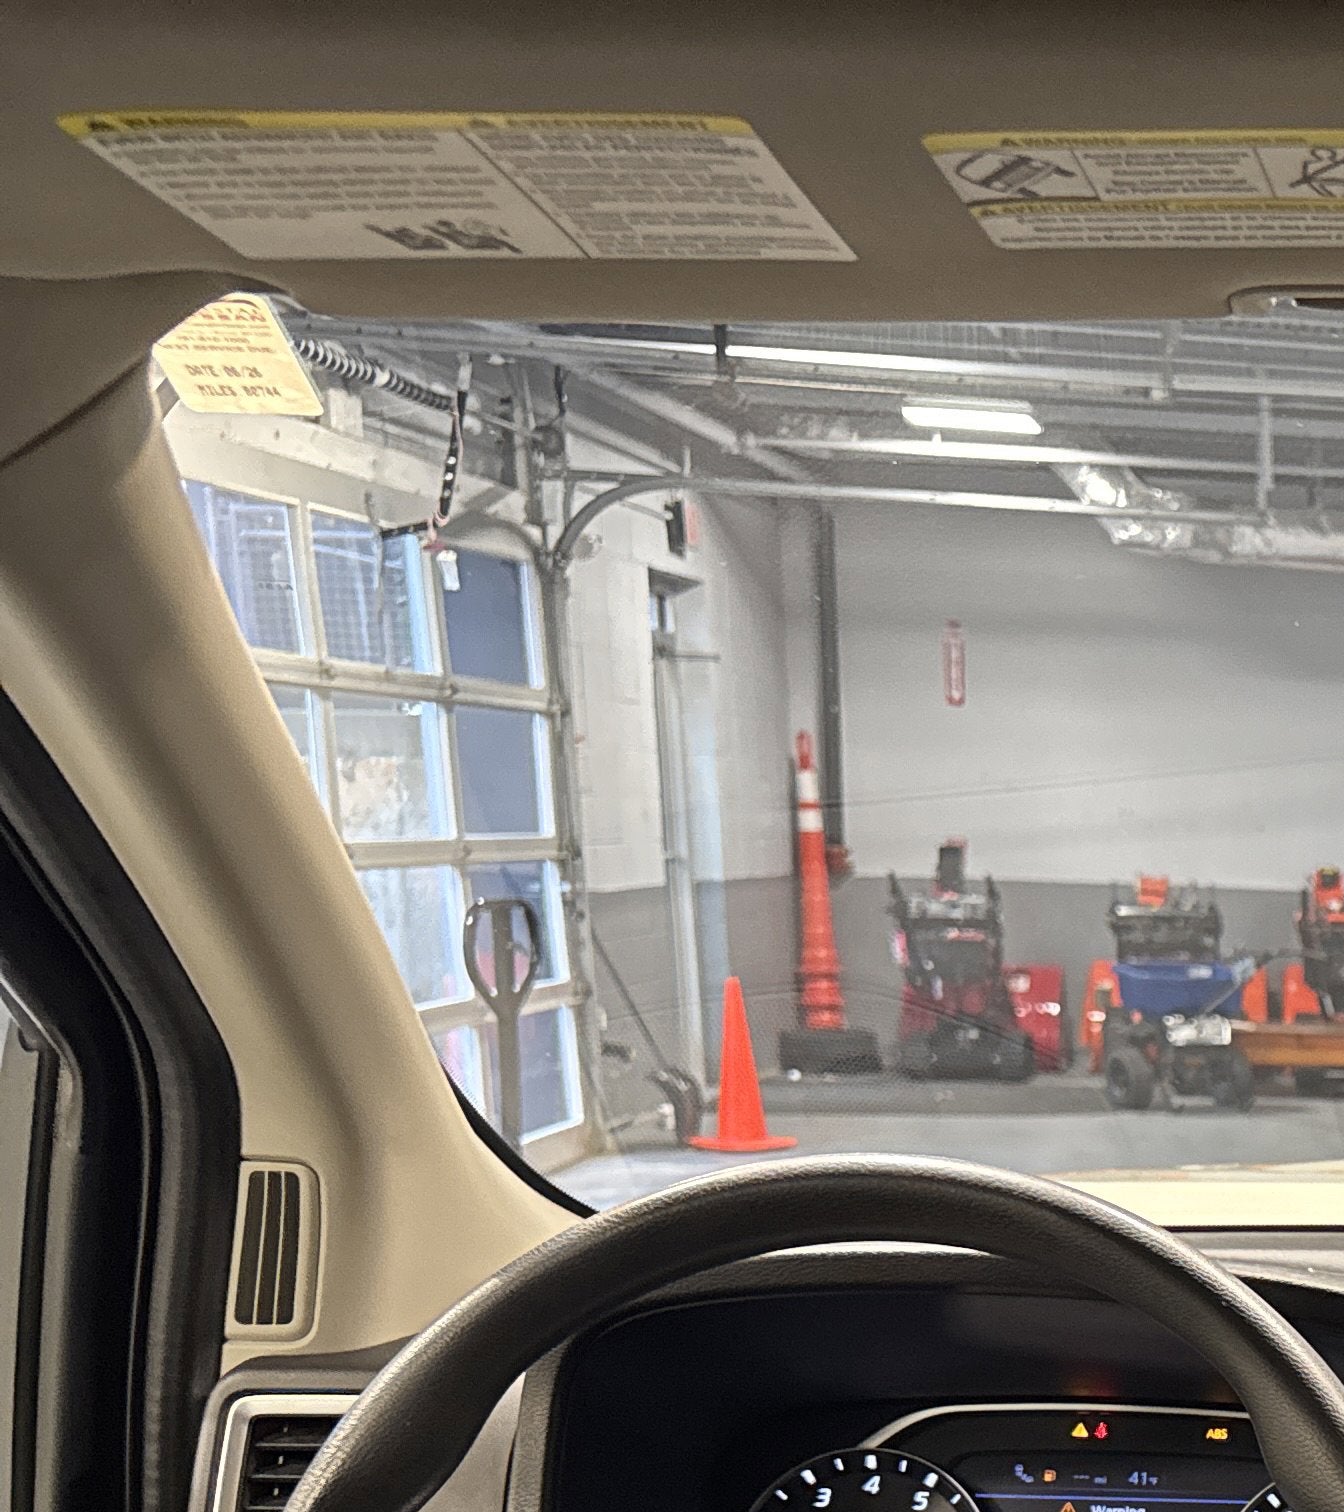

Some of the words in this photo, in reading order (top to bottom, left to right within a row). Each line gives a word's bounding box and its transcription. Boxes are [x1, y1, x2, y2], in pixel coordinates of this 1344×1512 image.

[185, 364, 219, 378] DATE
[196, 384, 238, 397] MILES
[1205, 1428, 1228, 1440] ABS
[861, 1475, 881, 1495] 4
[811, 1487, 832, 1508] 3
[911, 1490, 930, 1511] 5
